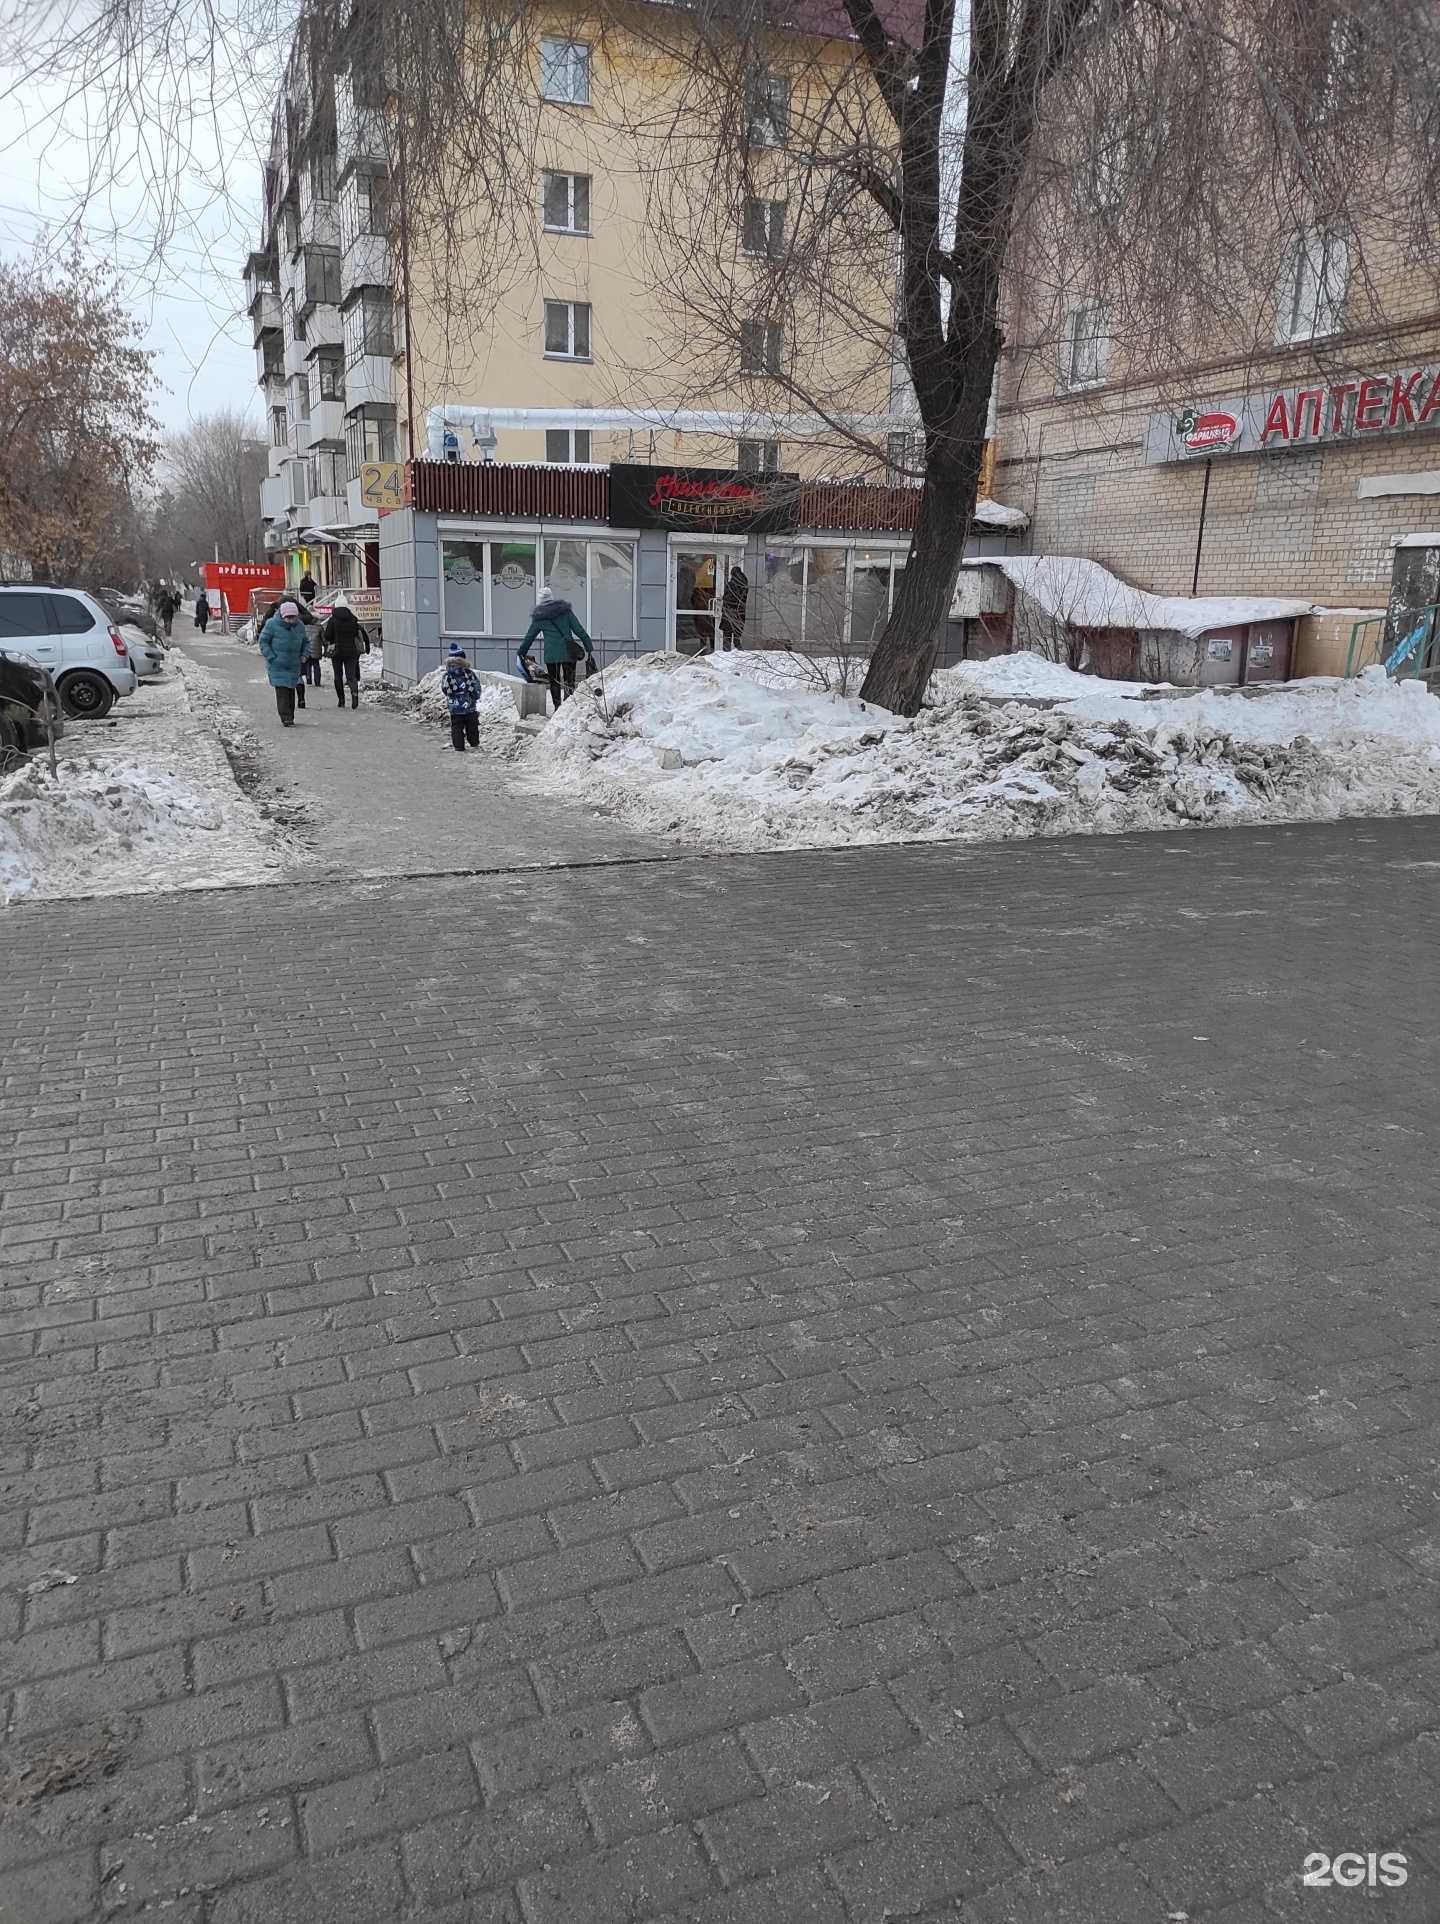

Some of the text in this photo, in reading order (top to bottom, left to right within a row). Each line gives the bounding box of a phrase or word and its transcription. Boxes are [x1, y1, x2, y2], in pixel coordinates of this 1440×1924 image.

[1260, 371, 1440, 441] АПТЕКА
[366, 468, 402, 496] 24
[218, 565, 270, 576] ПРОДУКТЫ
[350, 594, 380, 602] АТЕЛЬ
